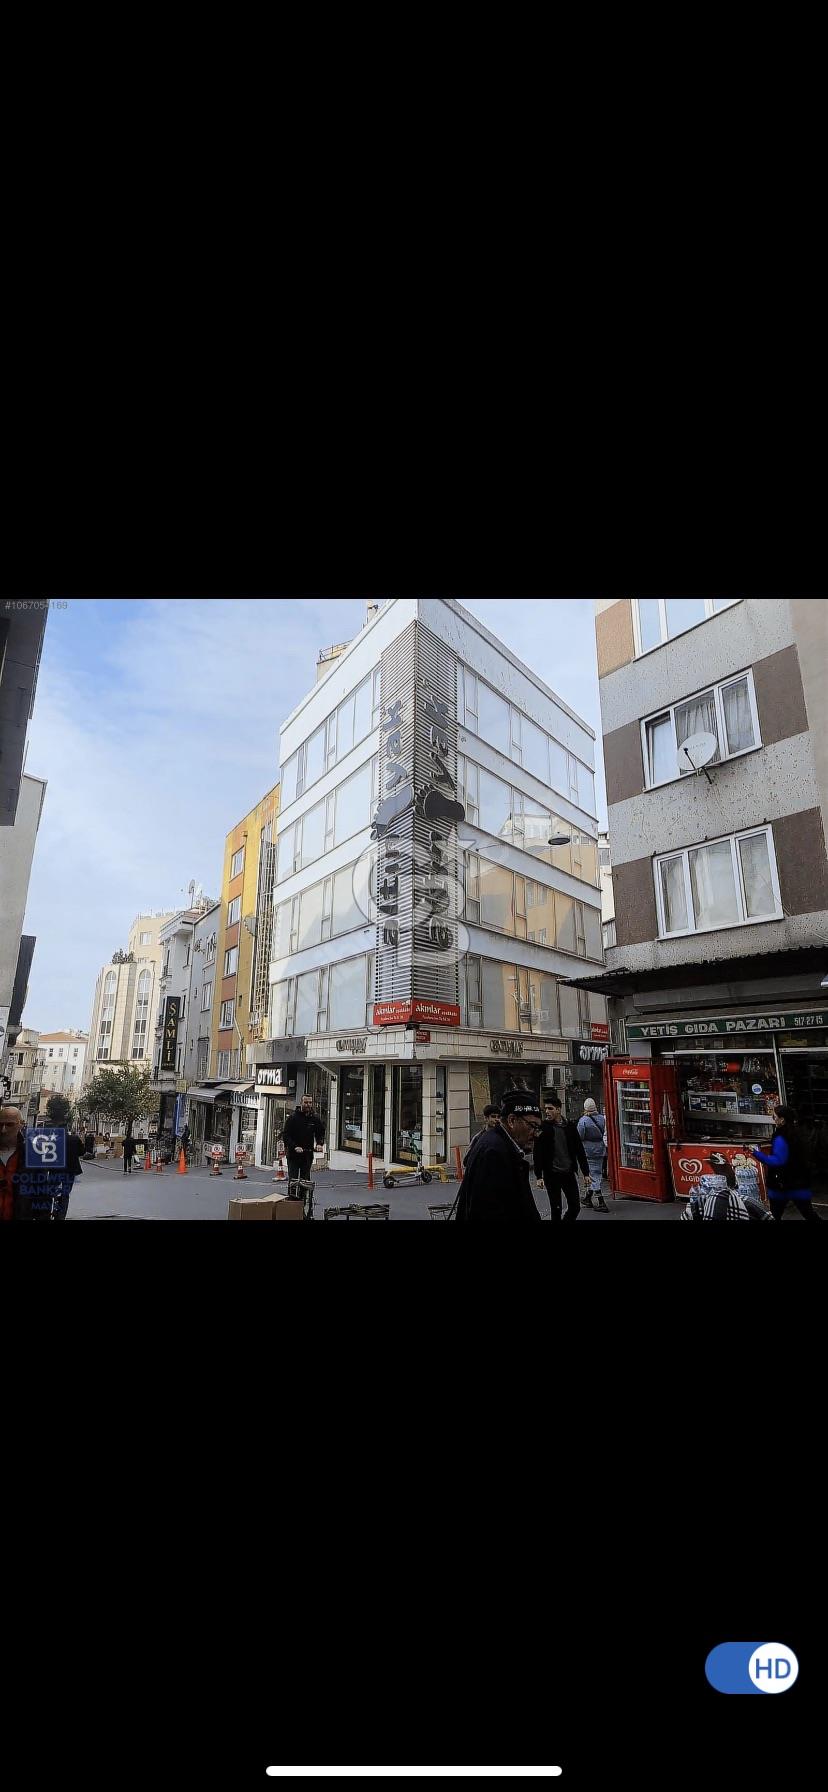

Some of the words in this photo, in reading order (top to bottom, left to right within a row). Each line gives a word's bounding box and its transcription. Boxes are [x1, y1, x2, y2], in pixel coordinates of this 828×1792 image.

[684, 1022, 719, 1033] GIDA
[726, 1017, 786, 1031] PAZARI
[680, 1175, 701, 1183] ALGID
